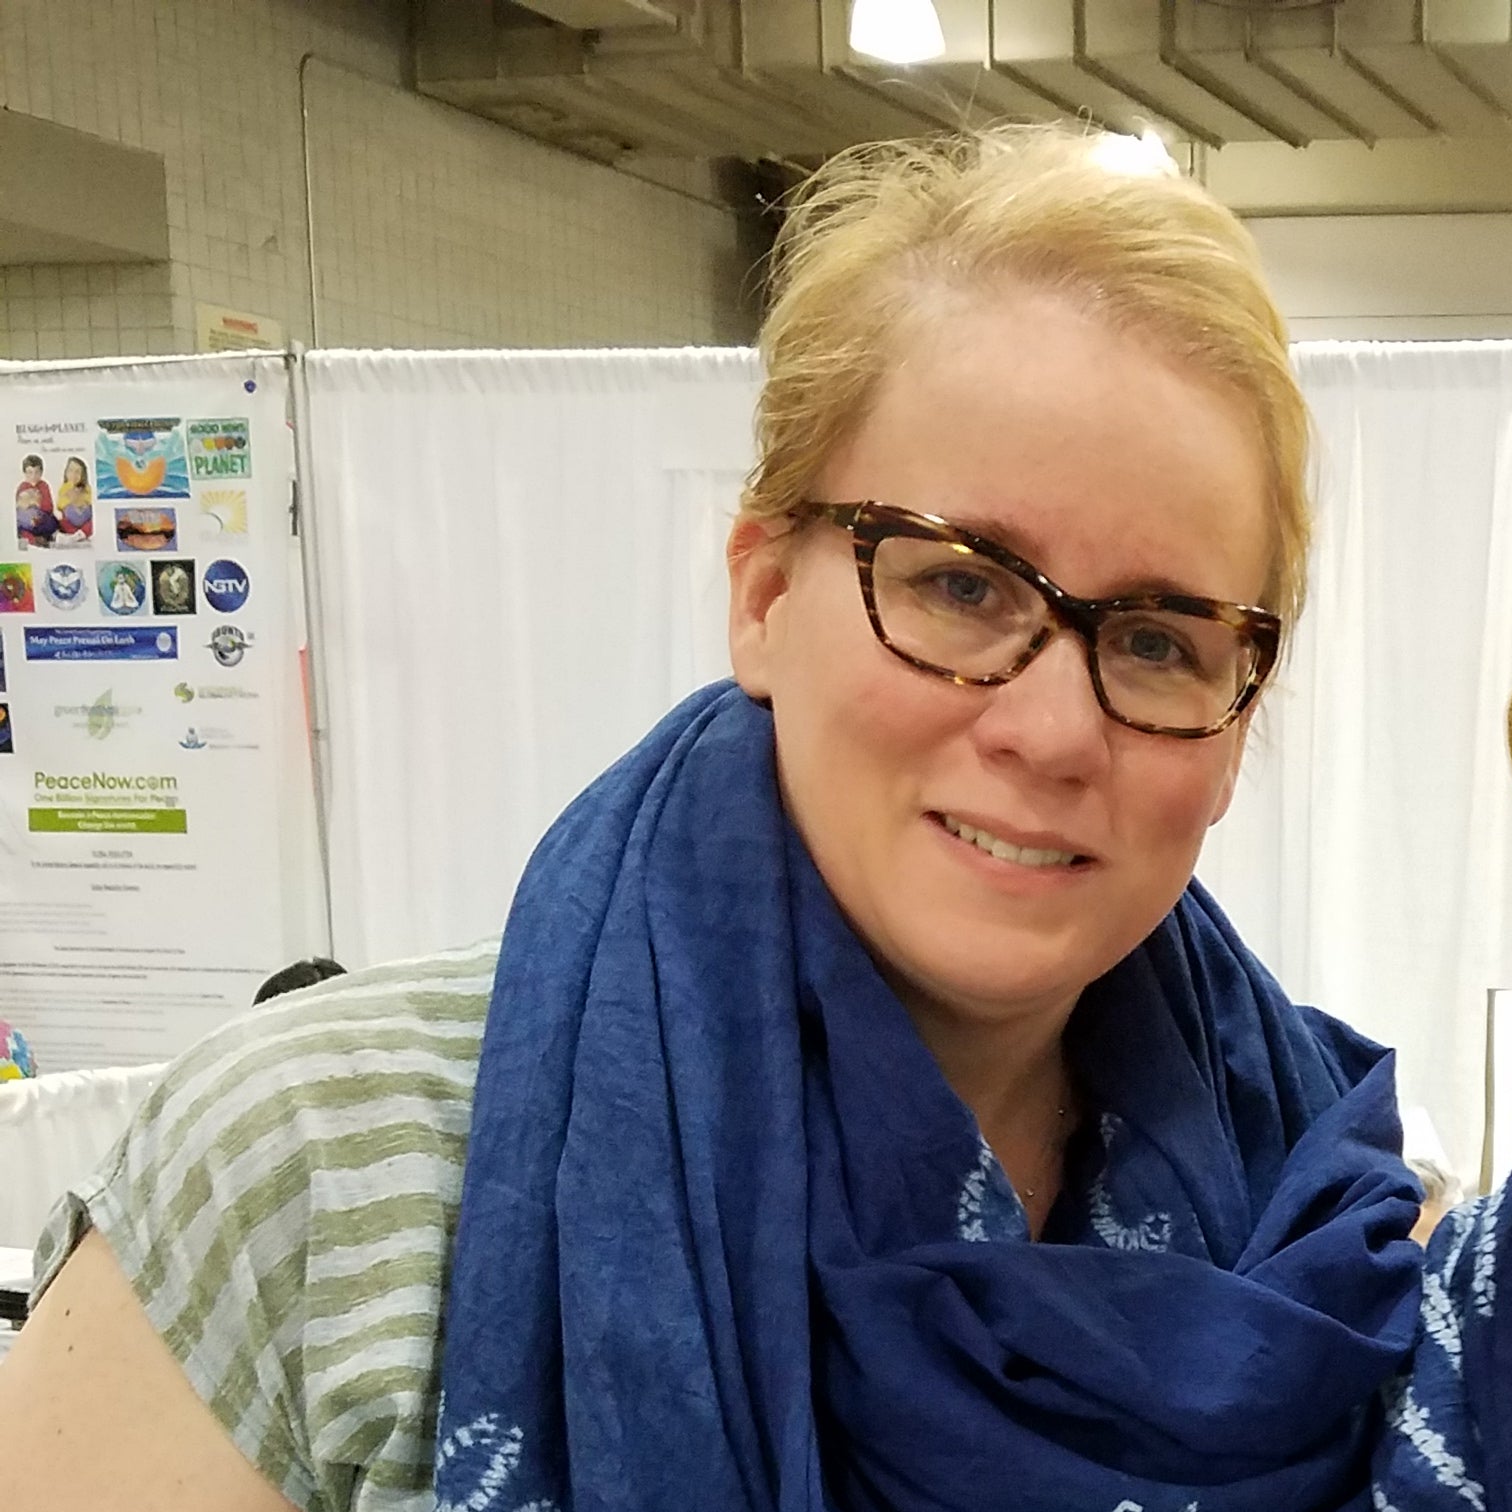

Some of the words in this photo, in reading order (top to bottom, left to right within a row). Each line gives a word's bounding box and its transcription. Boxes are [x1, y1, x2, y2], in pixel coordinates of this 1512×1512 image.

[194, 454, 248, 475] PLANET
[29, 635, 48, 646] May
[34, 771, 177, 790] PeaceNow.com
